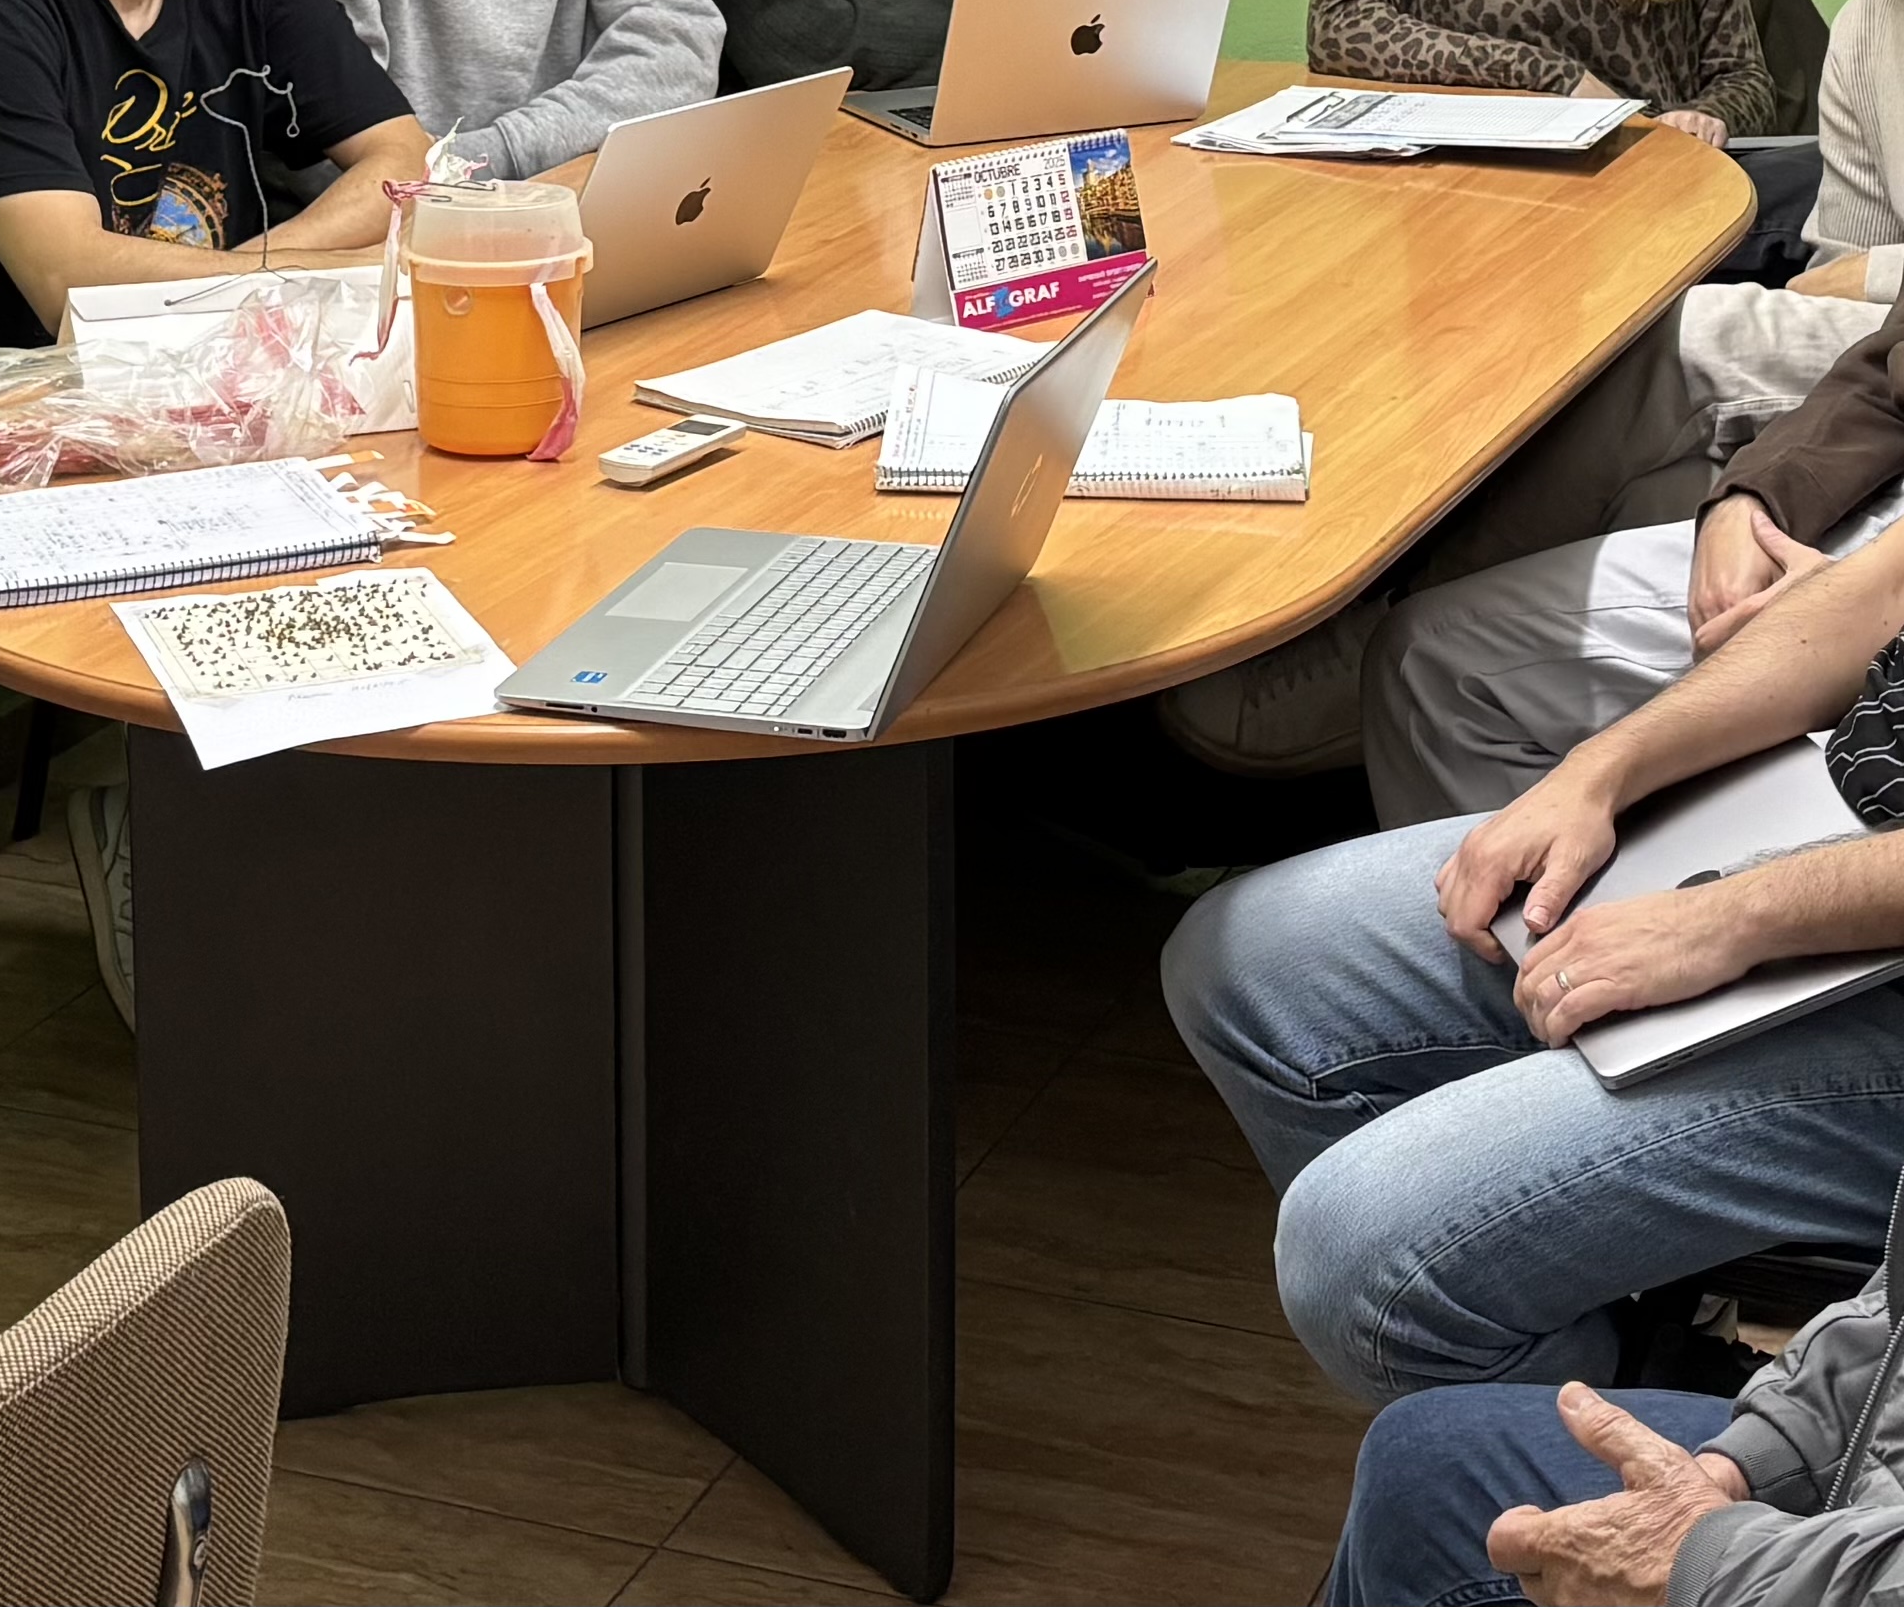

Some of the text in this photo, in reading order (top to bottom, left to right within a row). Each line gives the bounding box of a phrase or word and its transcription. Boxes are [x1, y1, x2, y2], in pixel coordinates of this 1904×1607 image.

[974, 155, 1066, 184] OCTUBRE 2025
[1021, 180, 1029, 194] 2
[1034, 178, 1041, 191] 3
[1046, 176, 1053, 188] 4
[987, 205, 995, 218] 6
[1012, 200, 1020, 213] 8
[1024, 198, 1032, 211] 9
[1036, 195, 1046, 208] 10
